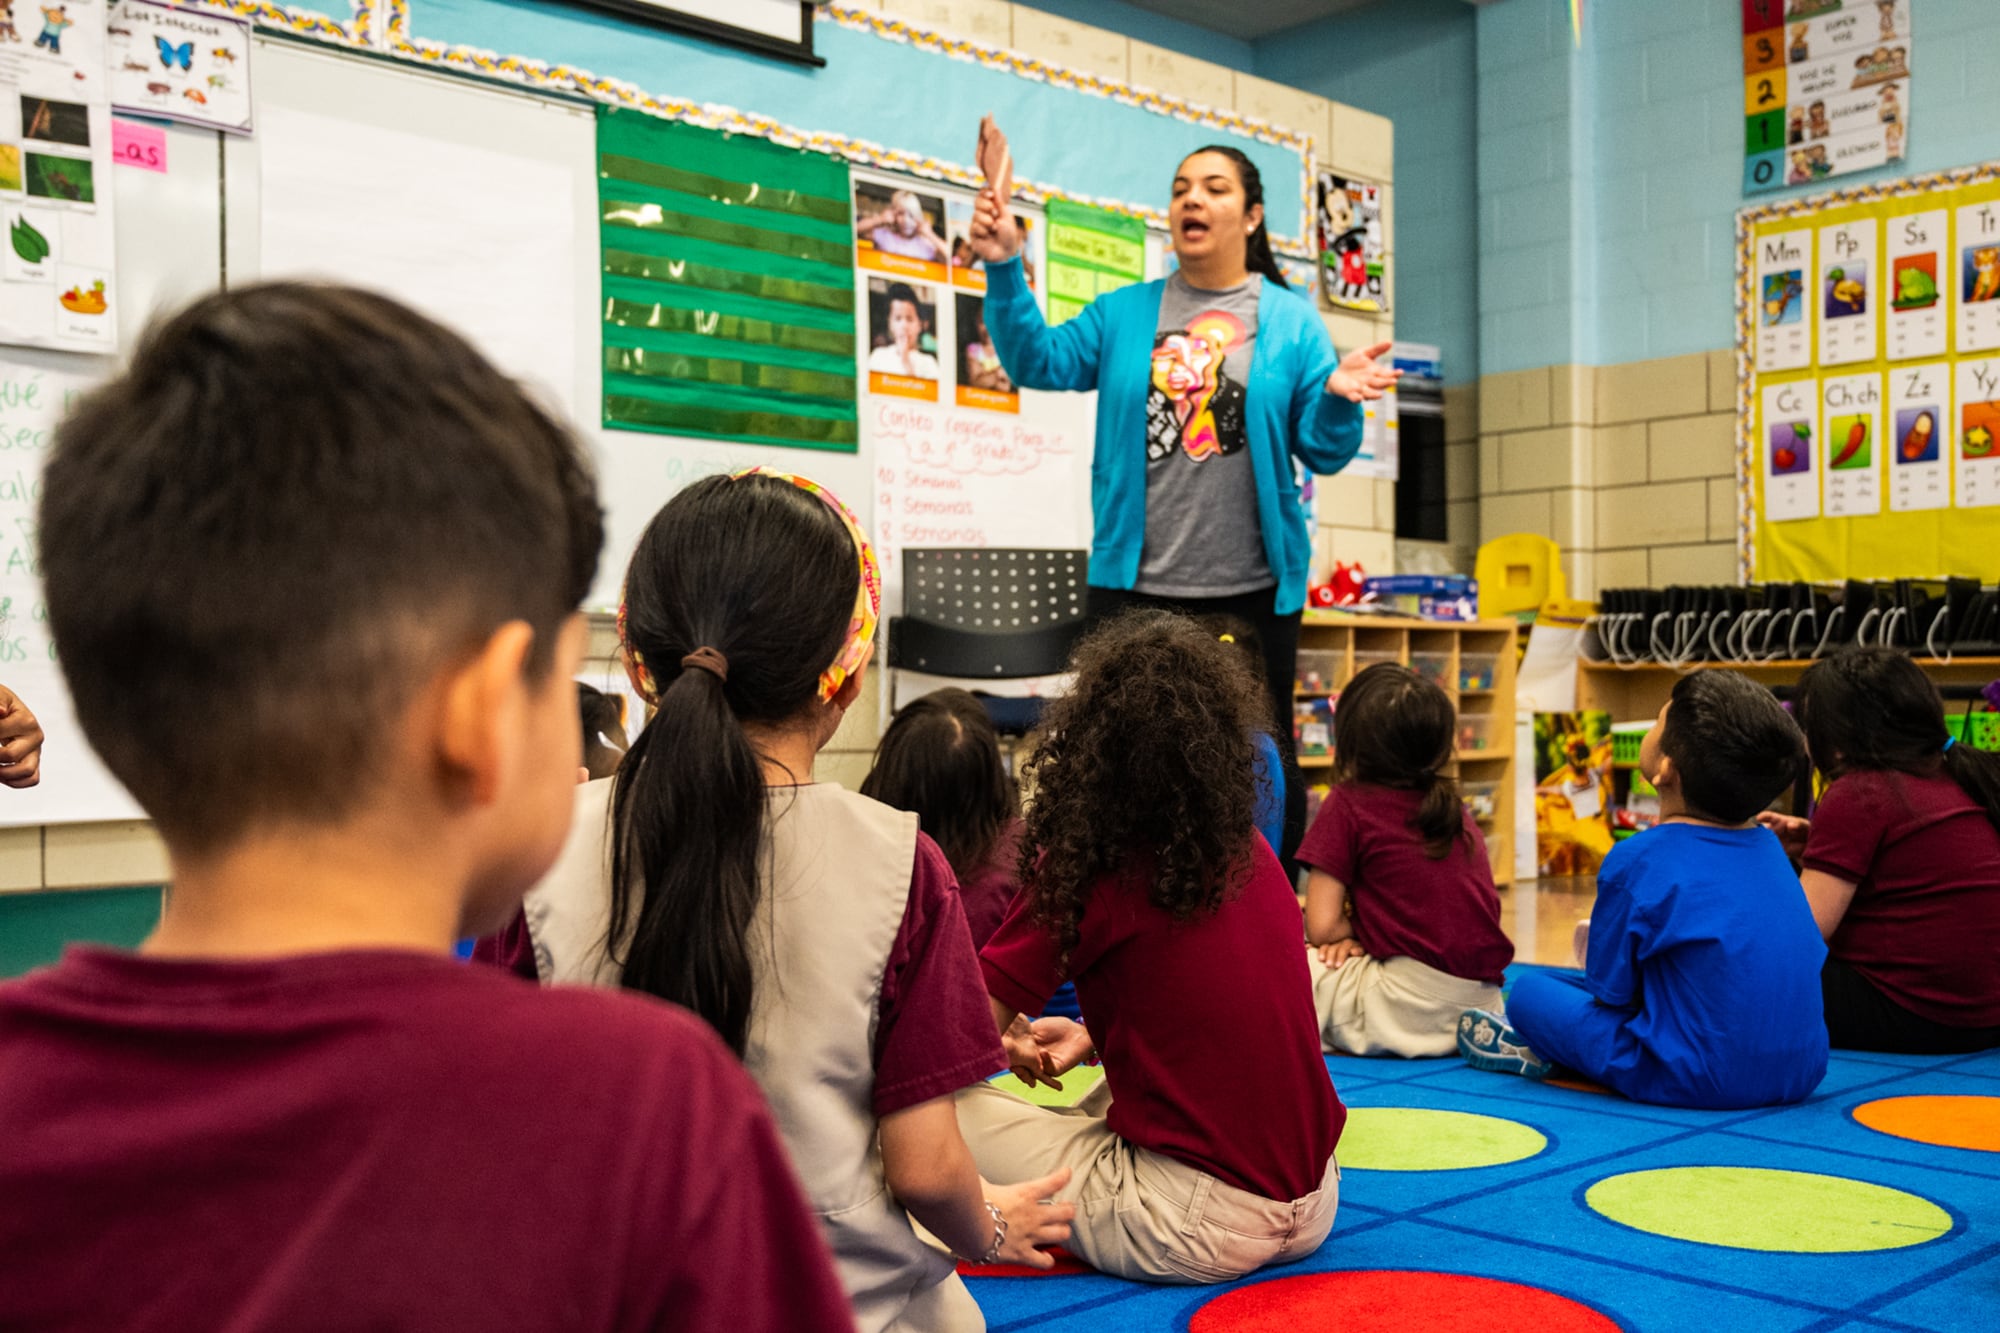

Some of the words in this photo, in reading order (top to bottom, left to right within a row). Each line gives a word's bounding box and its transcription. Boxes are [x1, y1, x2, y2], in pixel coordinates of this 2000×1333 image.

[1754, 0, 1770, 23] 4
[1755, 37, 1775, 64] 3
[1757, 79, 1776, 104] 2
[1760, 118, 1769, 145] 1
[1754, 160, 1774, 184] 0
[1905, 221, 1927, 246] Ss
[1977, 210, 1995, 233] Tt
[1764, 242, 1800, 264] Mm
[1836, 231, 1858, 257] Pp
[1825, 385, 1853, 408] Ch
[1857, 381, 1879, 405] ch
[1906, 375, 1931, 399] Zz
[1973, 367, 1998, 401] Yy
[1776, 389, 1802, 413] Cc
